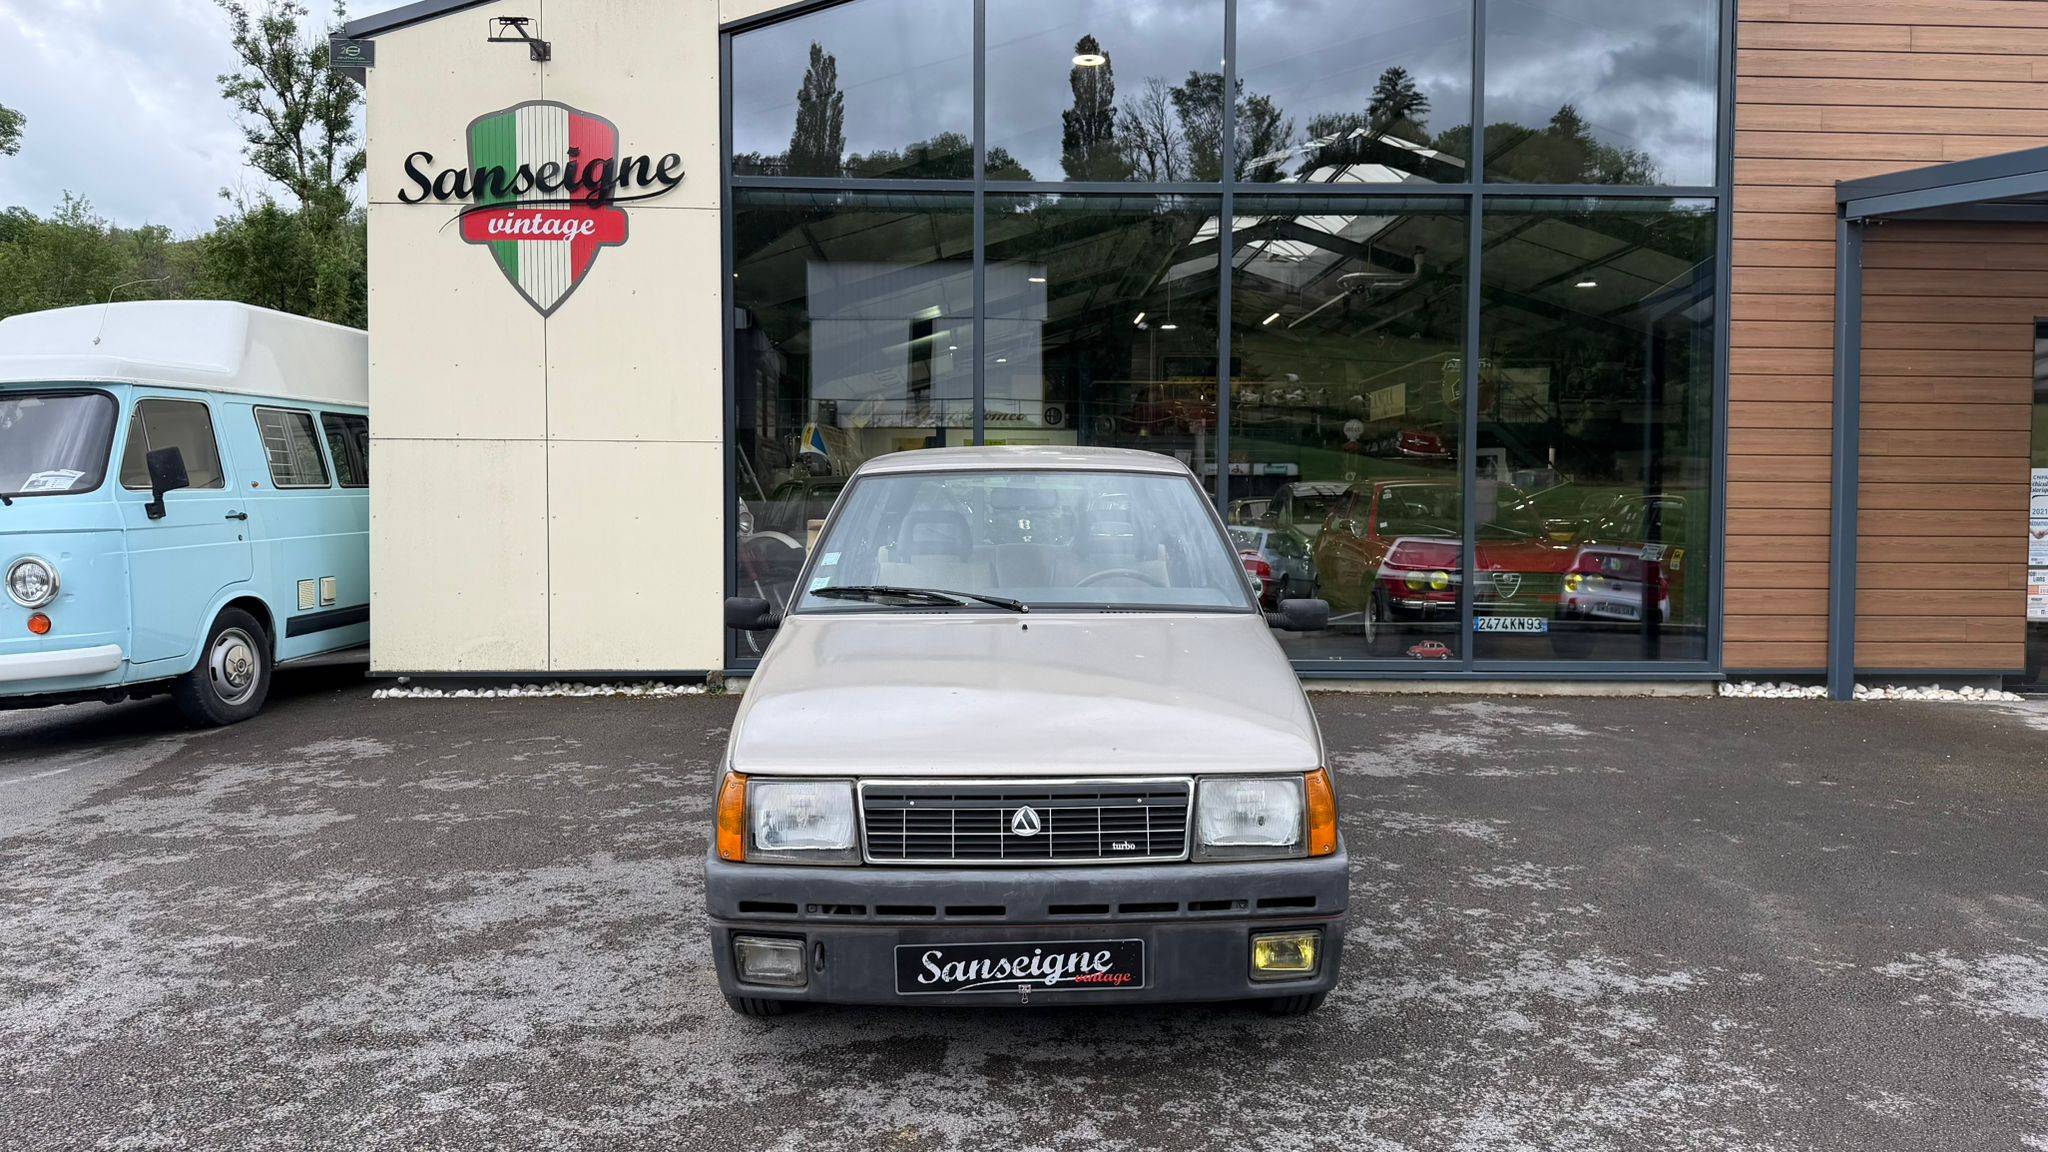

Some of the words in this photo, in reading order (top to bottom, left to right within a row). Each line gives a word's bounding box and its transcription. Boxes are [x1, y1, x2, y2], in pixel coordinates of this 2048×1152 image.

[397, 146, 686, 208] Sanseigne
[487, 211, 596, 242] vintage
[1479, 617, 1541, 631] 2474KN93
[1112, 841, 1136, 850] turbo
[917, 948, 1116, 985] Sanseigne
[1074, 970, 1132, 986] vintage
